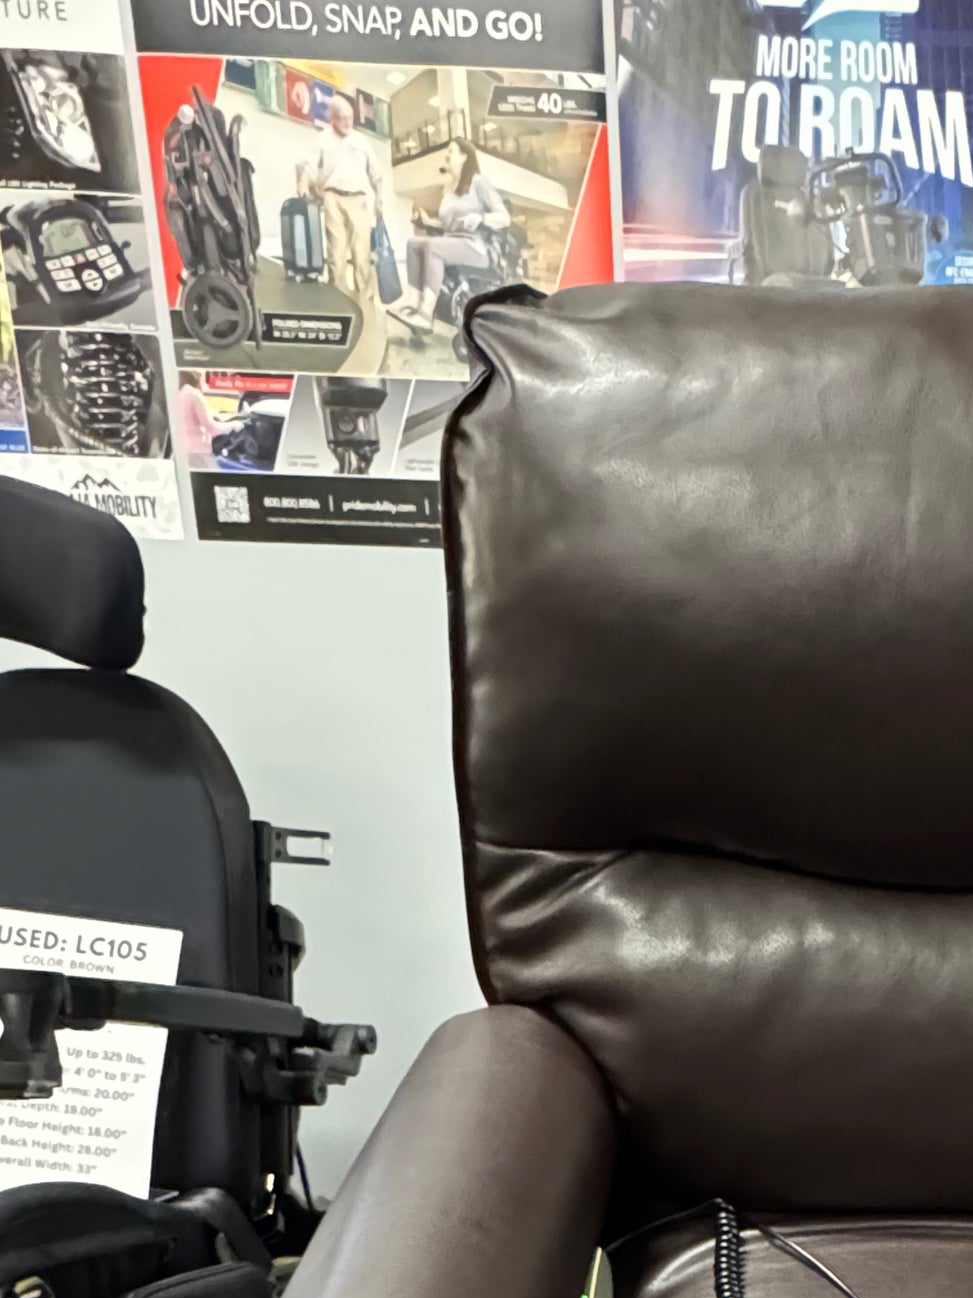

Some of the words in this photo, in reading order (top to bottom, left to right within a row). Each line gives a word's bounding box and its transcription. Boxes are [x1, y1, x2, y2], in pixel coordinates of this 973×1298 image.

[189, 0, 317, 36] UNFOLD,
[325, 3, 402, 40] SNAP,
[409, 6, 479, 38] AND
[485, 10, 543, 42] GO!
[756, 34, 833, 80] MORE
[840, 40, 919, 85] ROOM
[537, 92, 562, 114] 40
[709, 79, 782, 171] TO
[95, 493, 157, 519] MOBILITY
[0, 925, 67, 953] USED:
[76, 934, 148, 962] LC105
[23, 954, 65, 968] COLOR
[70, 960, 115, 974] BROWN
[67, 1047, 83, 1059] Up
[86, 1049, 99, 1059] to
[125, 1052, 146, 1065] lbs.
[104, 1071, 117, 1081] to
[8, 1116, 39, 1129] Floor
